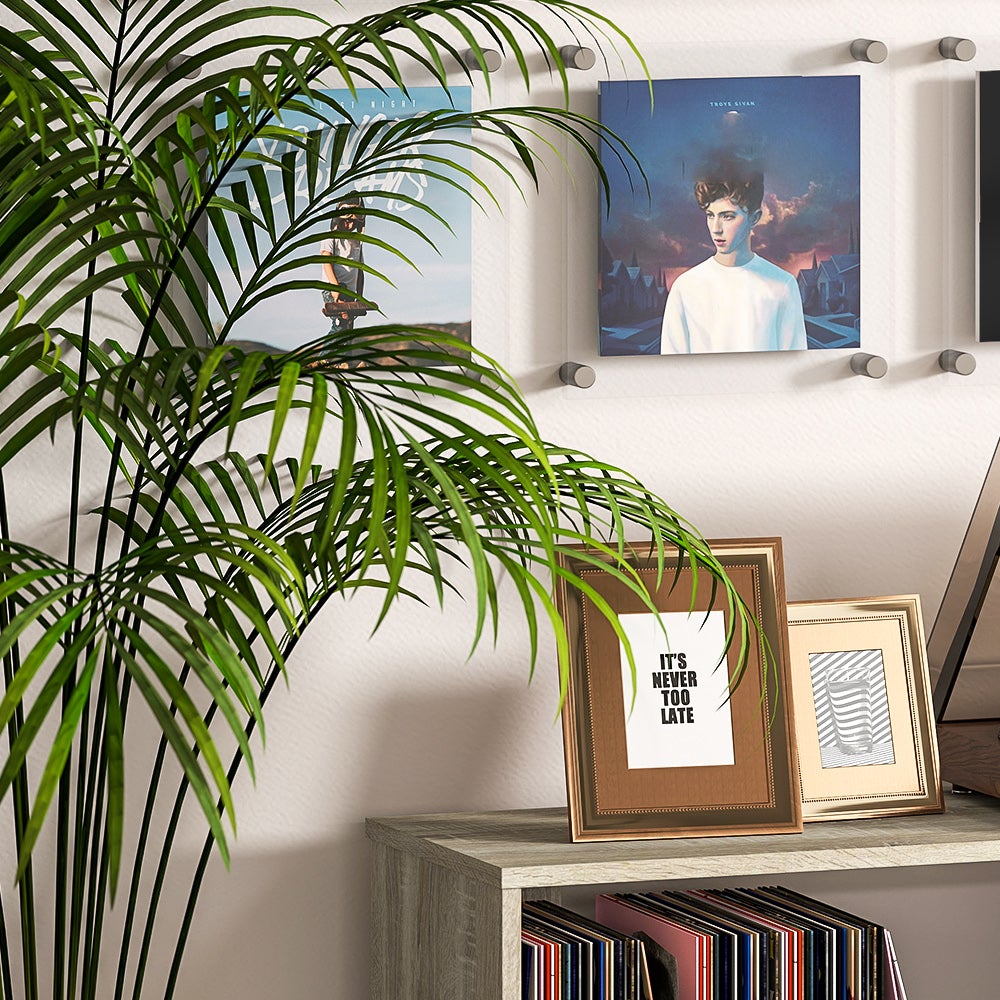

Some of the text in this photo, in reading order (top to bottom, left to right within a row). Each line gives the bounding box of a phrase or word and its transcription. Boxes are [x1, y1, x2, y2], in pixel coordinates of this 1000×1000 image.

[319, 99, 416, 110] LST NIGHT
[660, 652, 688, 670] IT'S
[652, 671, 698, 689] NEVER
[661, 689, 691, 707] TOO
[661, 707, 695, 724] LATE
